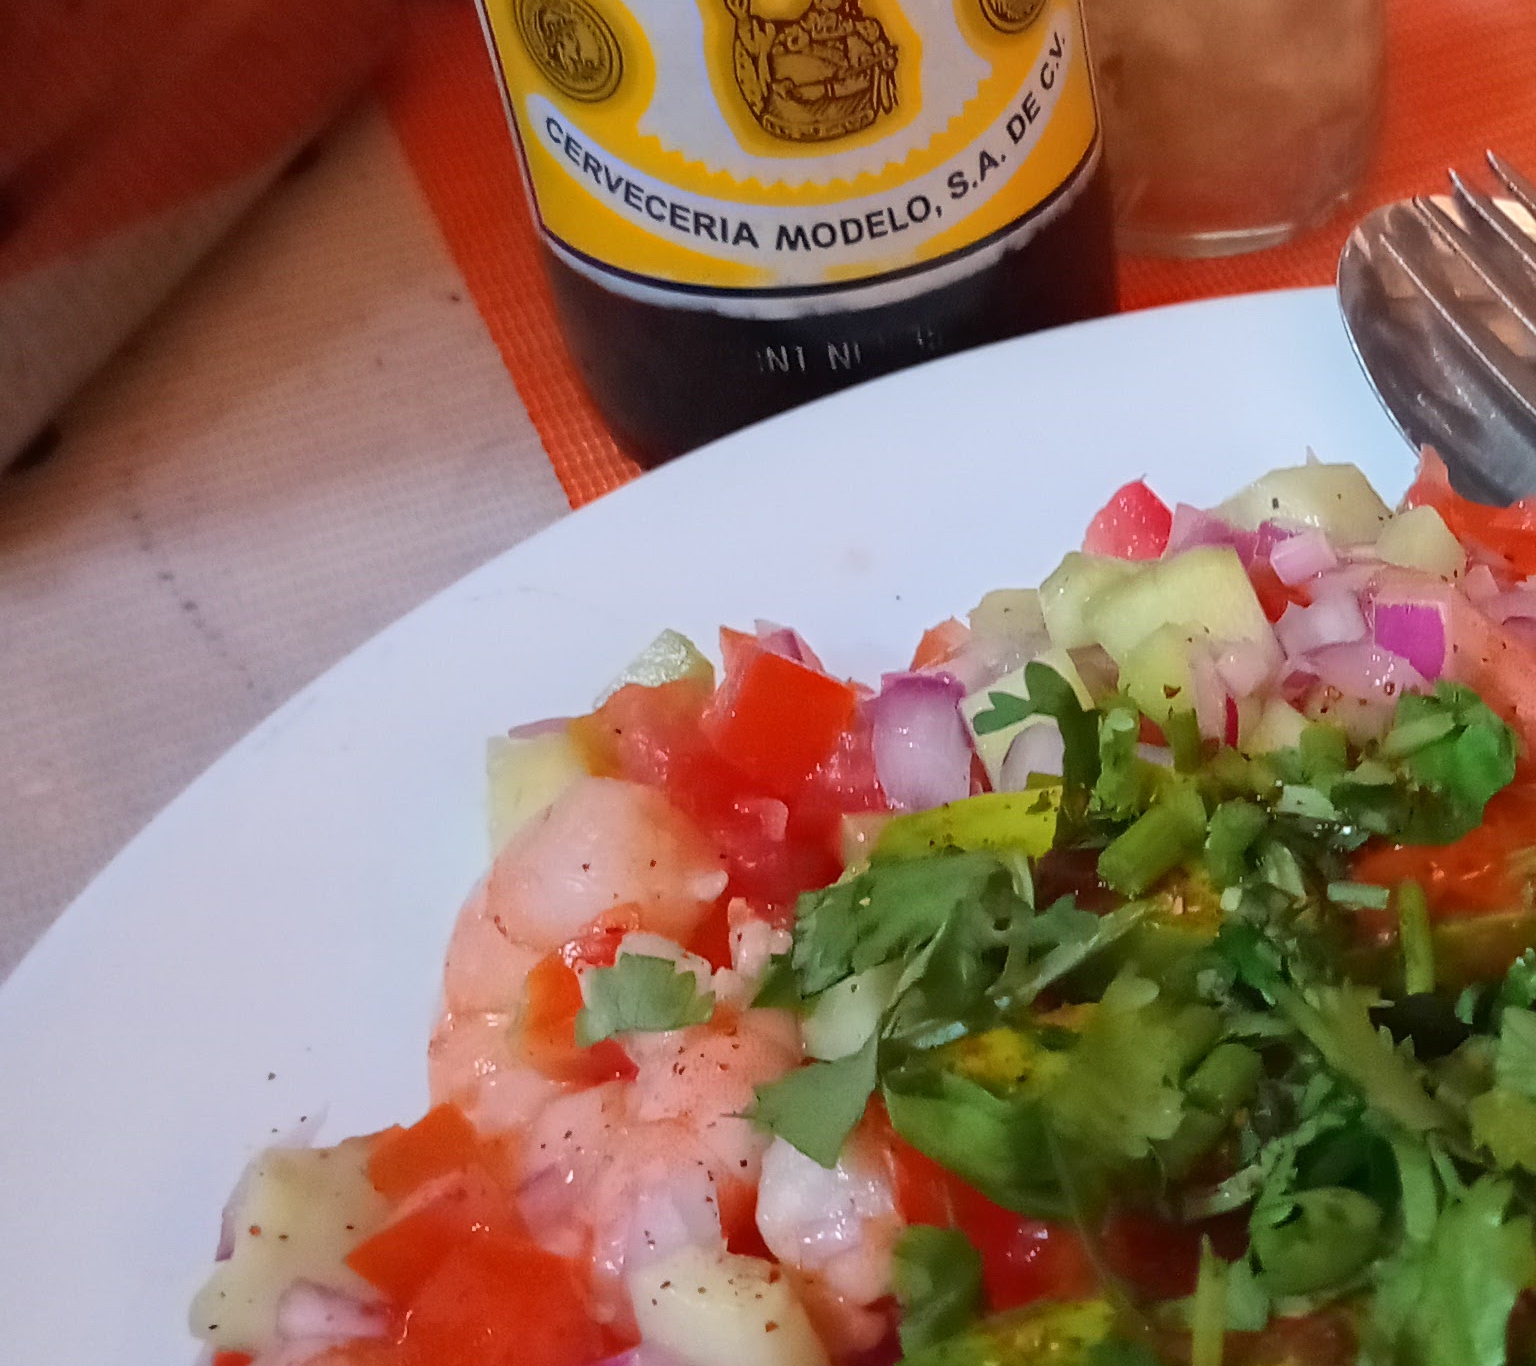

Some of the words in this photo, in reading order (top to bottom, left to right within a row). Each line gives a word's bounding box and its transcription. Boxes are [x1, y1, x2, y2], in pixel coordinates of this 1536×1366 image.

[545, 115, 760, 250] CERVECERIA
[775, 195, 942, 251] MODELO,
[947, 150, 1006, 199] S.A.
[1006, 92, 1041, 144] DE
[1041, 31, 1066, 90] C.V.
